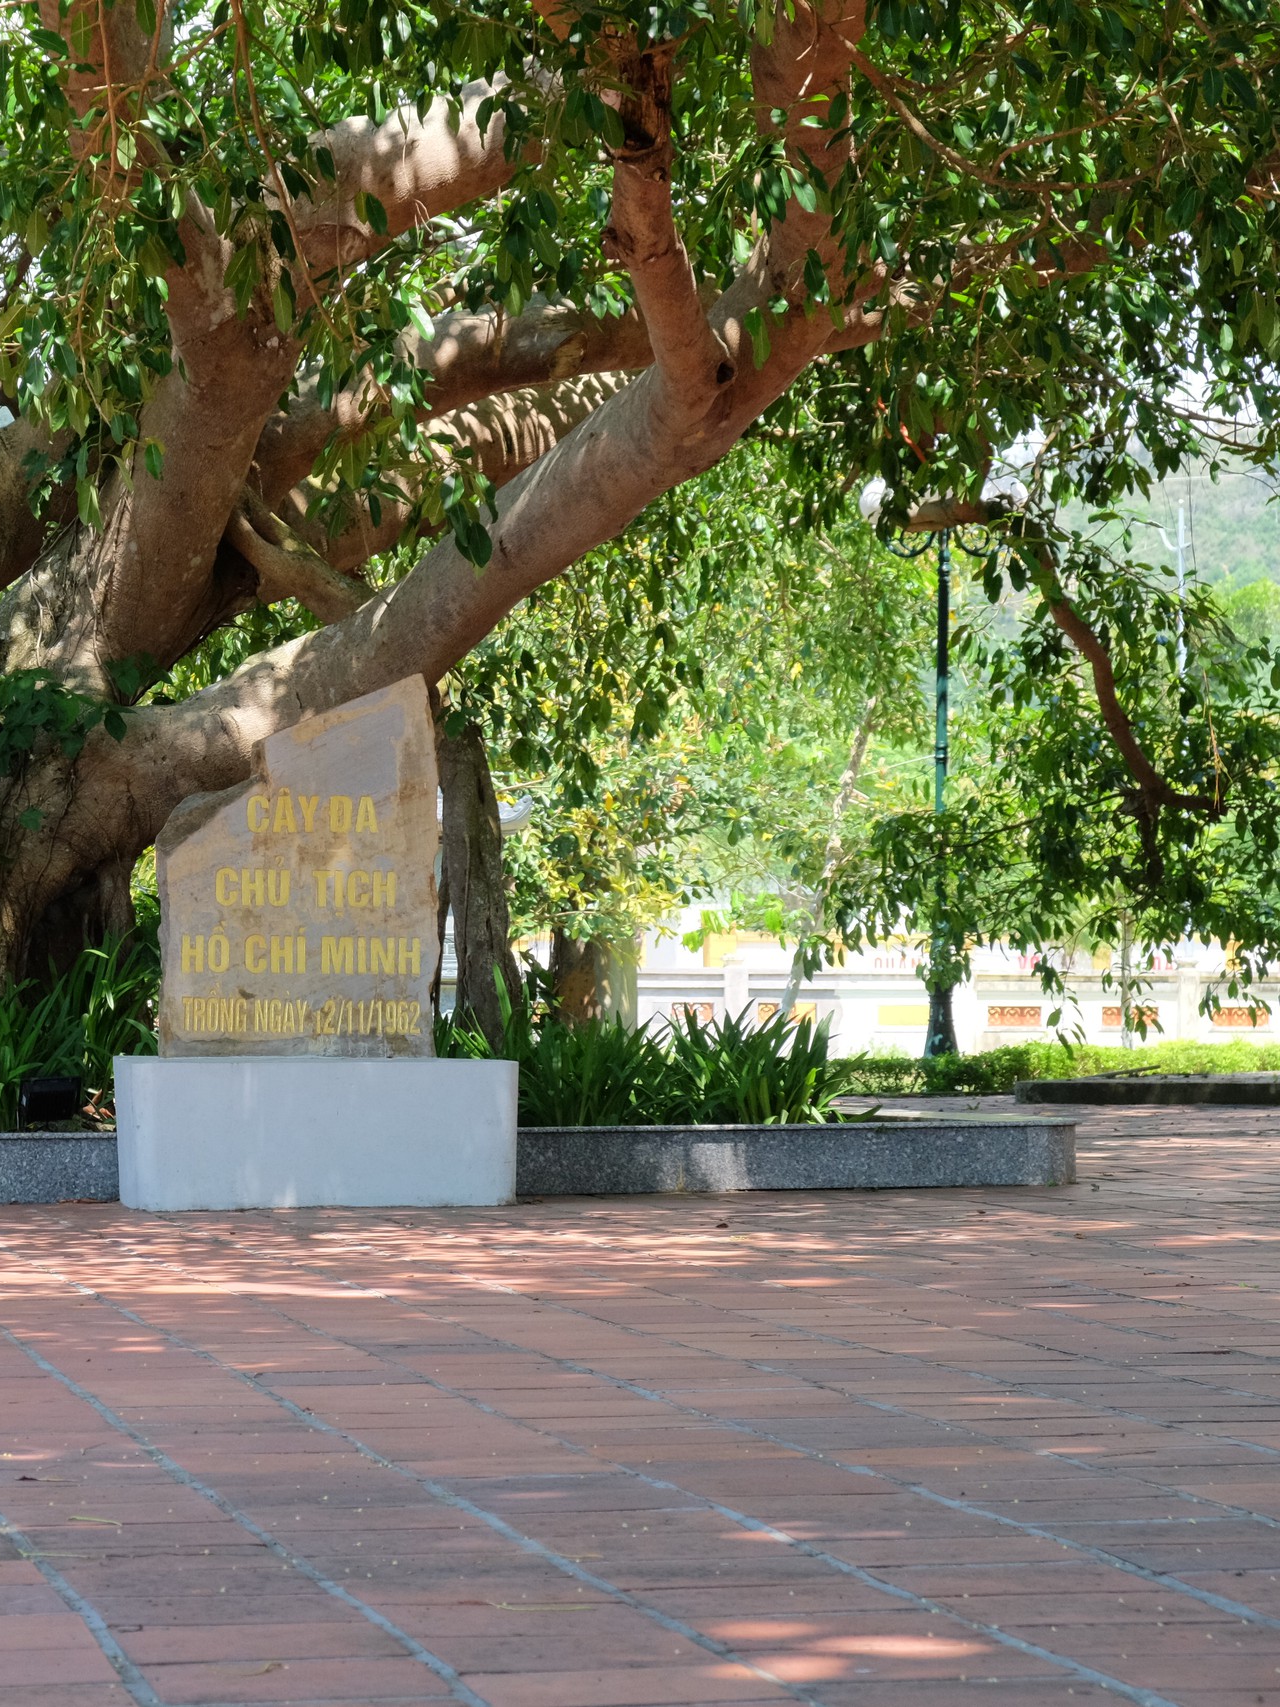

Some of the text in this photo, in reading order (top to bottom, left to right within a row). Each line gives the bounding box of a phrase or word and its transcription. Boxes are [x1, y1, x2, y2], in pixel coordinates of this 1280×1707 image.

[247, 788, 378, 833] CÂY ĐA
[215, 855, 397, 917] CHỦ TỊCH
[181, 920, 420, 975] HỒ CHÍ MINH
[182, 983, 421, 1036] TRỒNG NGÀY 12/11/1962
